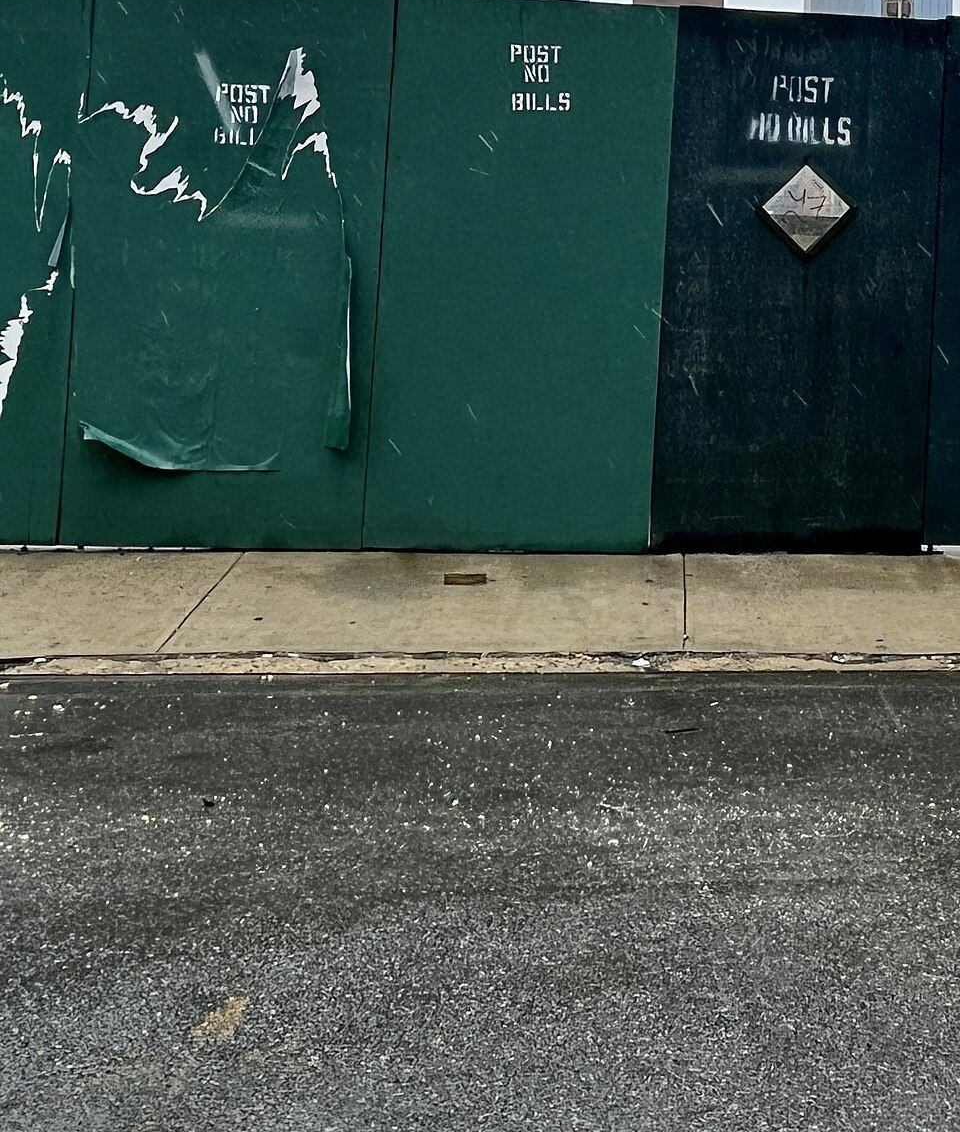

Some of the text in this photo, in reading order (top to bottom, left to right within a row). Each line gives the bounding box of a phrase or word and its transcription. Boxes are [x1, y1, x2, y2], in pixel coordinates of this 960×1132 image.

[511, 44, 562, 64] POST
[524, 63, 549, 83] NO
[215, 82, 271, 104] POST
[772, 74, 835, 103] POST
[511, 92, 571, 112] BILLS
[230, 105, 258, 124] NO
[213, 126, 255, 146] BILL
[748, 111, 851, 146] NO BILLS
